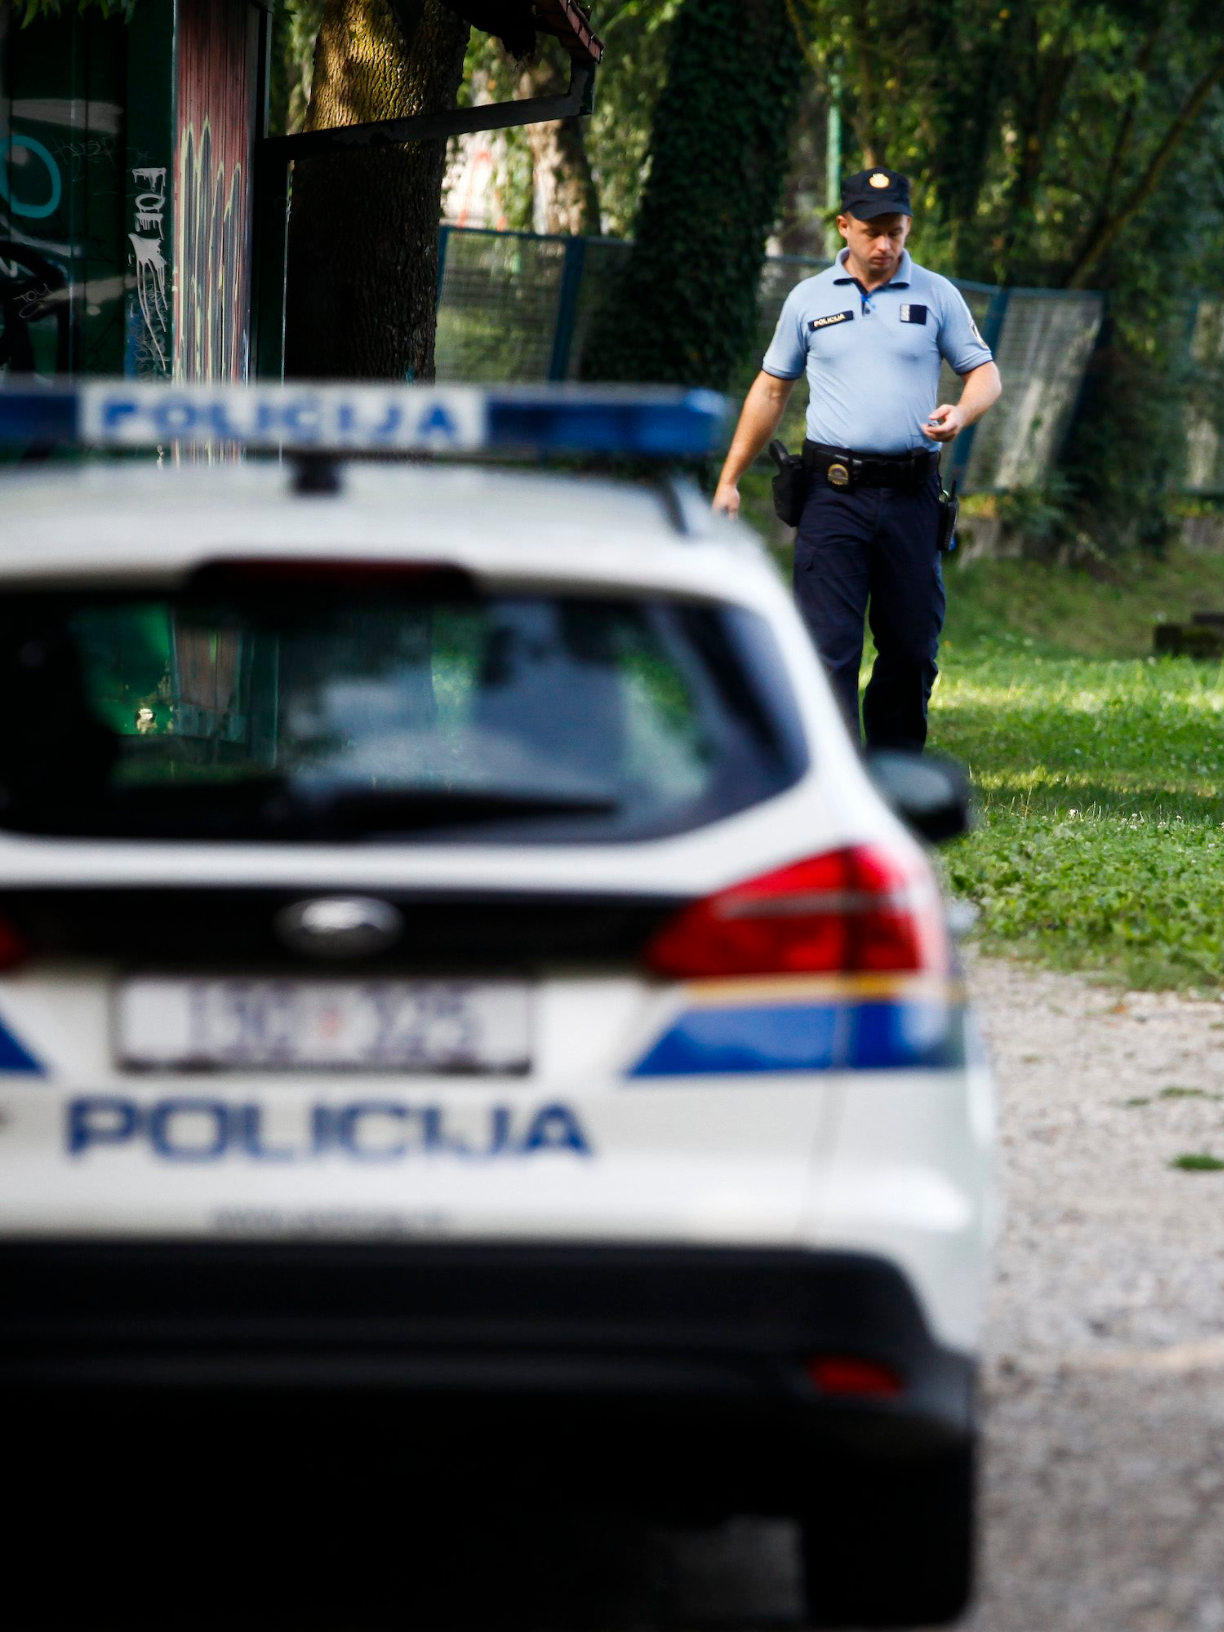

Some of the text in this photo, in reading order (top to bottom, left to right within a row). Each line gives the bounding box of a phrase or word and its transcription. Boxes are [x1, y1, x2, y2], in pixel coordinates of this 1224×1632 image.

[813, 313, 846, 328] POLICIJA
[103, 401, 458, 442] POLICIJA
[65, 1096, 594, 1161] POLICIJA
